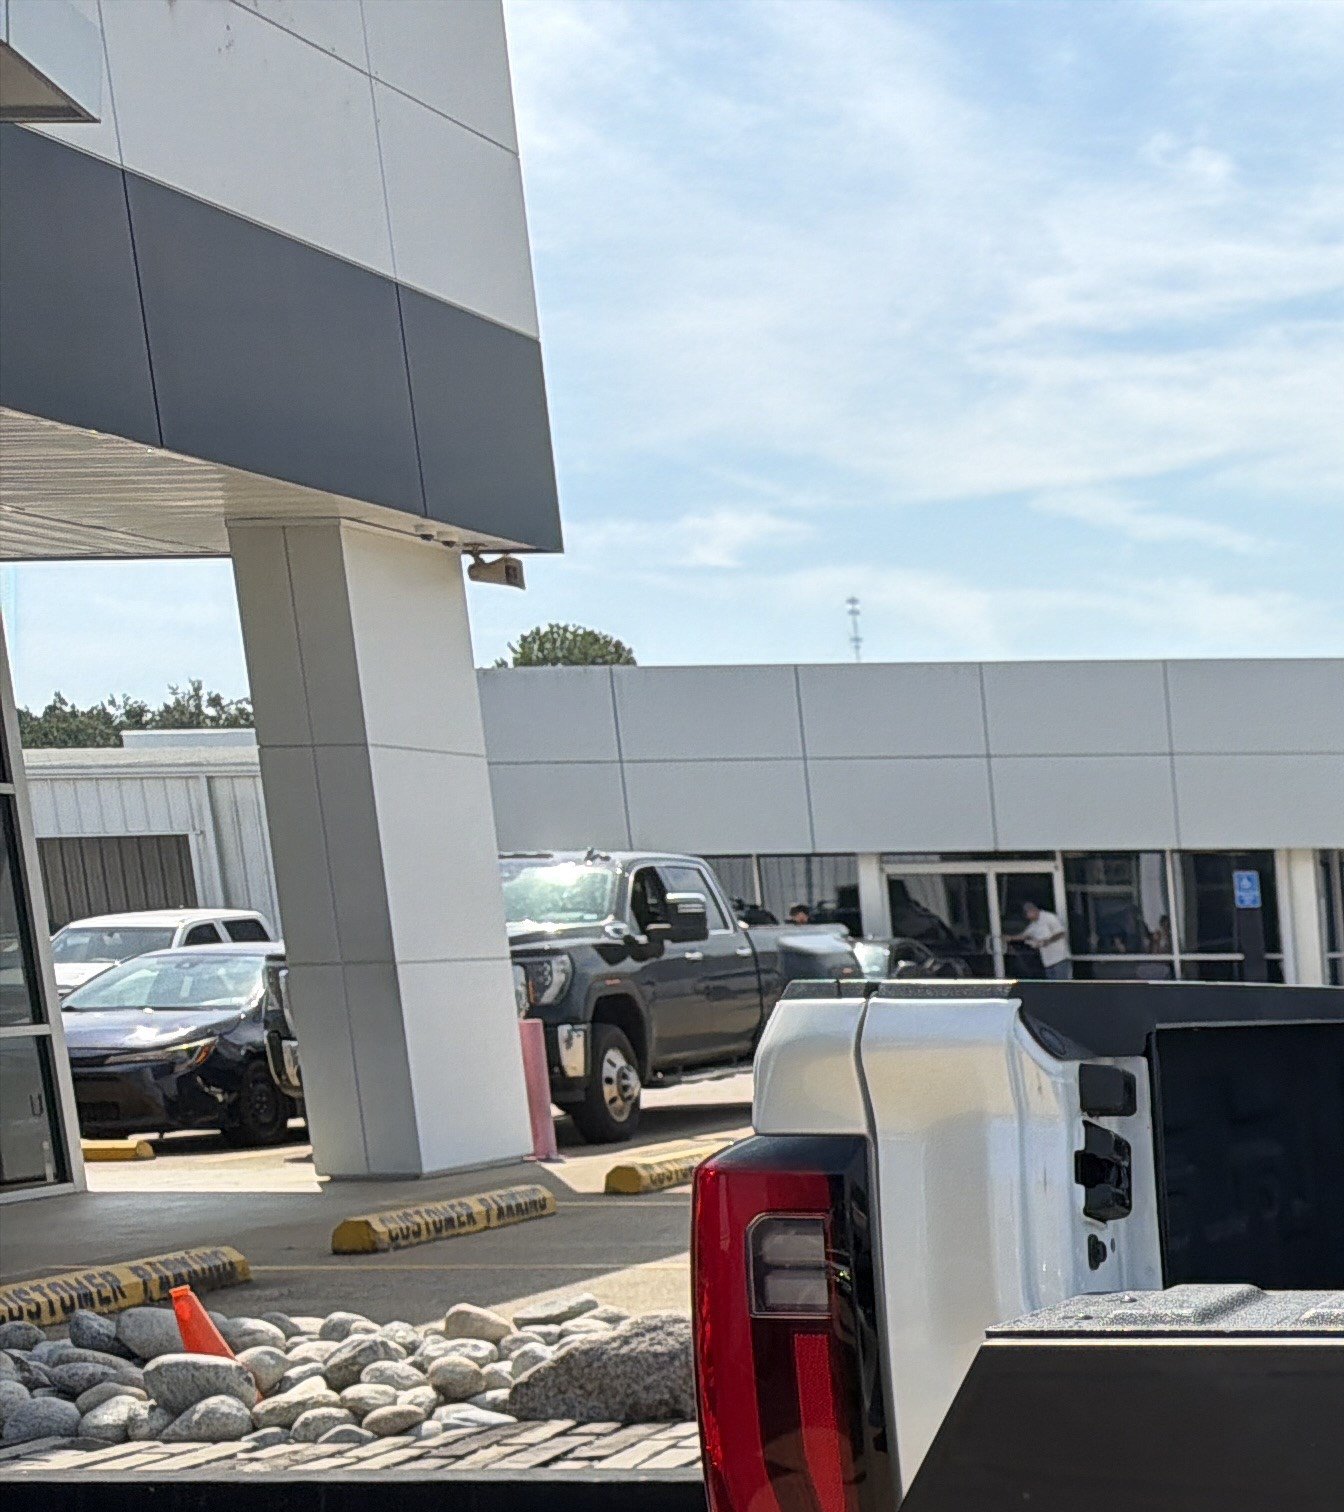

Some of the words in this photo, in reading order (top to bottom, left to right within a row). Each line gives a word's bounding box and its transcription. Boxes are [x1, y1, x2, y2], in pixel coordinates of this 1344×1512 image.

[378, 1201, 477, 1242] CUSTOMER
[476, 1187, 548, 1224] PARKING
[0, 1270, 127, 1324] USTOMER
